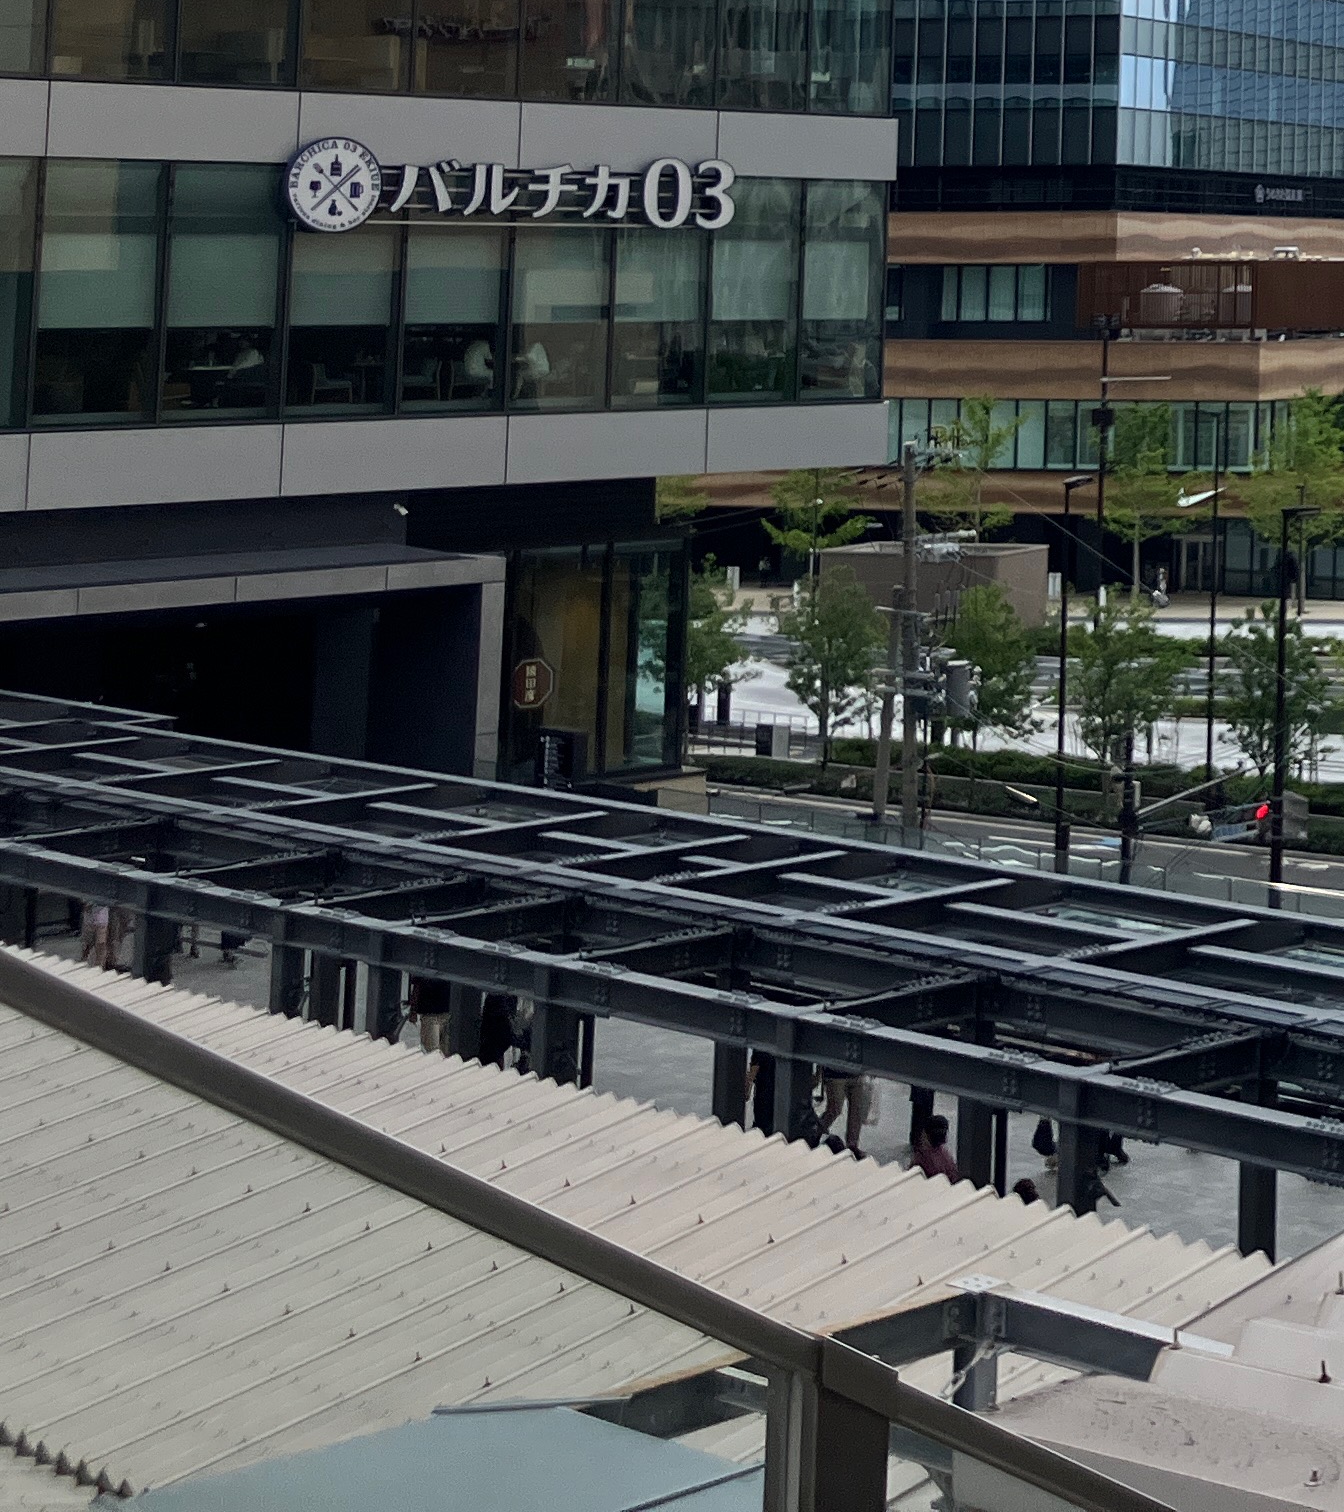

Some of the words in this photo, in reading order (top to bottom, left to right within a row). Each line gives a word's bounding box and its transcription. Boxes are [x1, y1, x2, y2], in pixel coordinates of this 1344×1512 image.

[289, 140, 339, 189] BARCHICA
[343, 141, 358, 153] 03
[390, 158, 736, 230] バルチカ03
